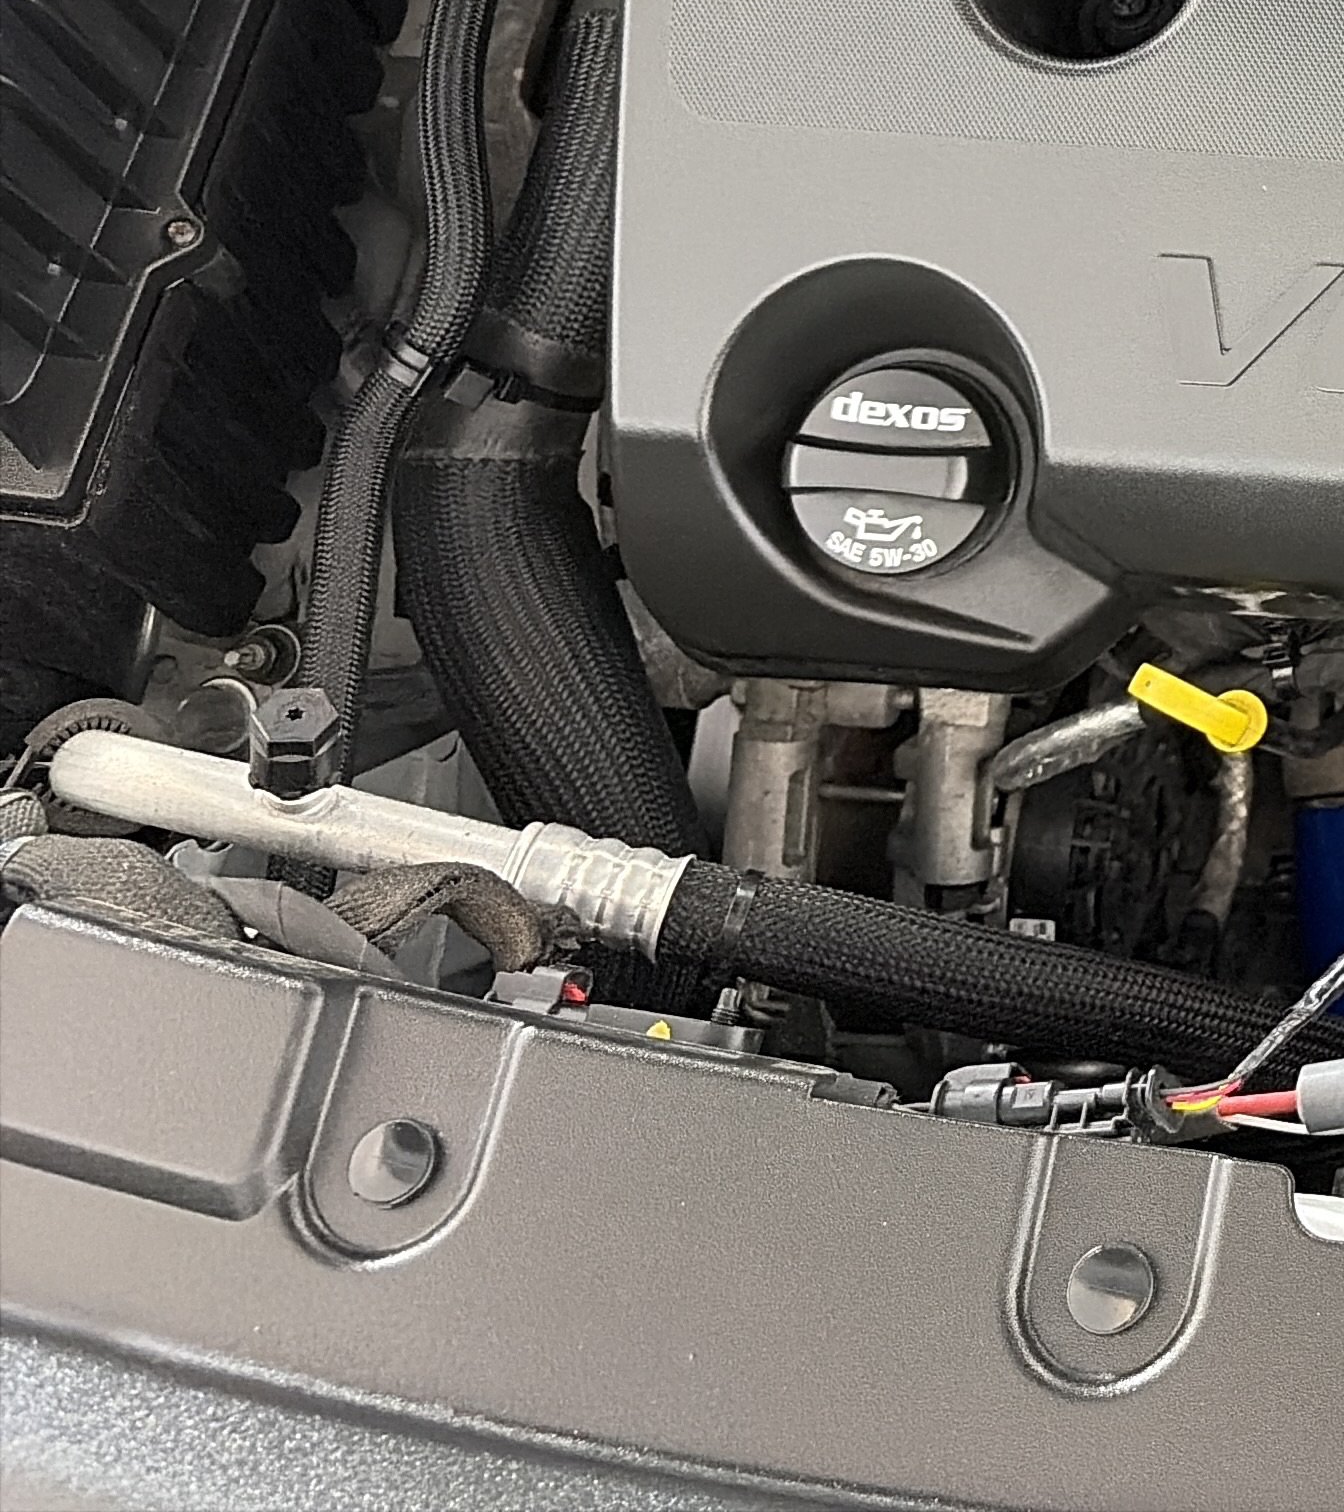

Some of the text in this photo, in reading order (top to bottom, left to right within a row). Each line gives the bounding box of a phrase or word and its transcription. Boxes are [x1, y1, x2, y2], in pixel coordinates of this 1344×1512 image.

[830, 391, 972, 432] dexos
[826, 531, 939, 568] SAE 5W-30
